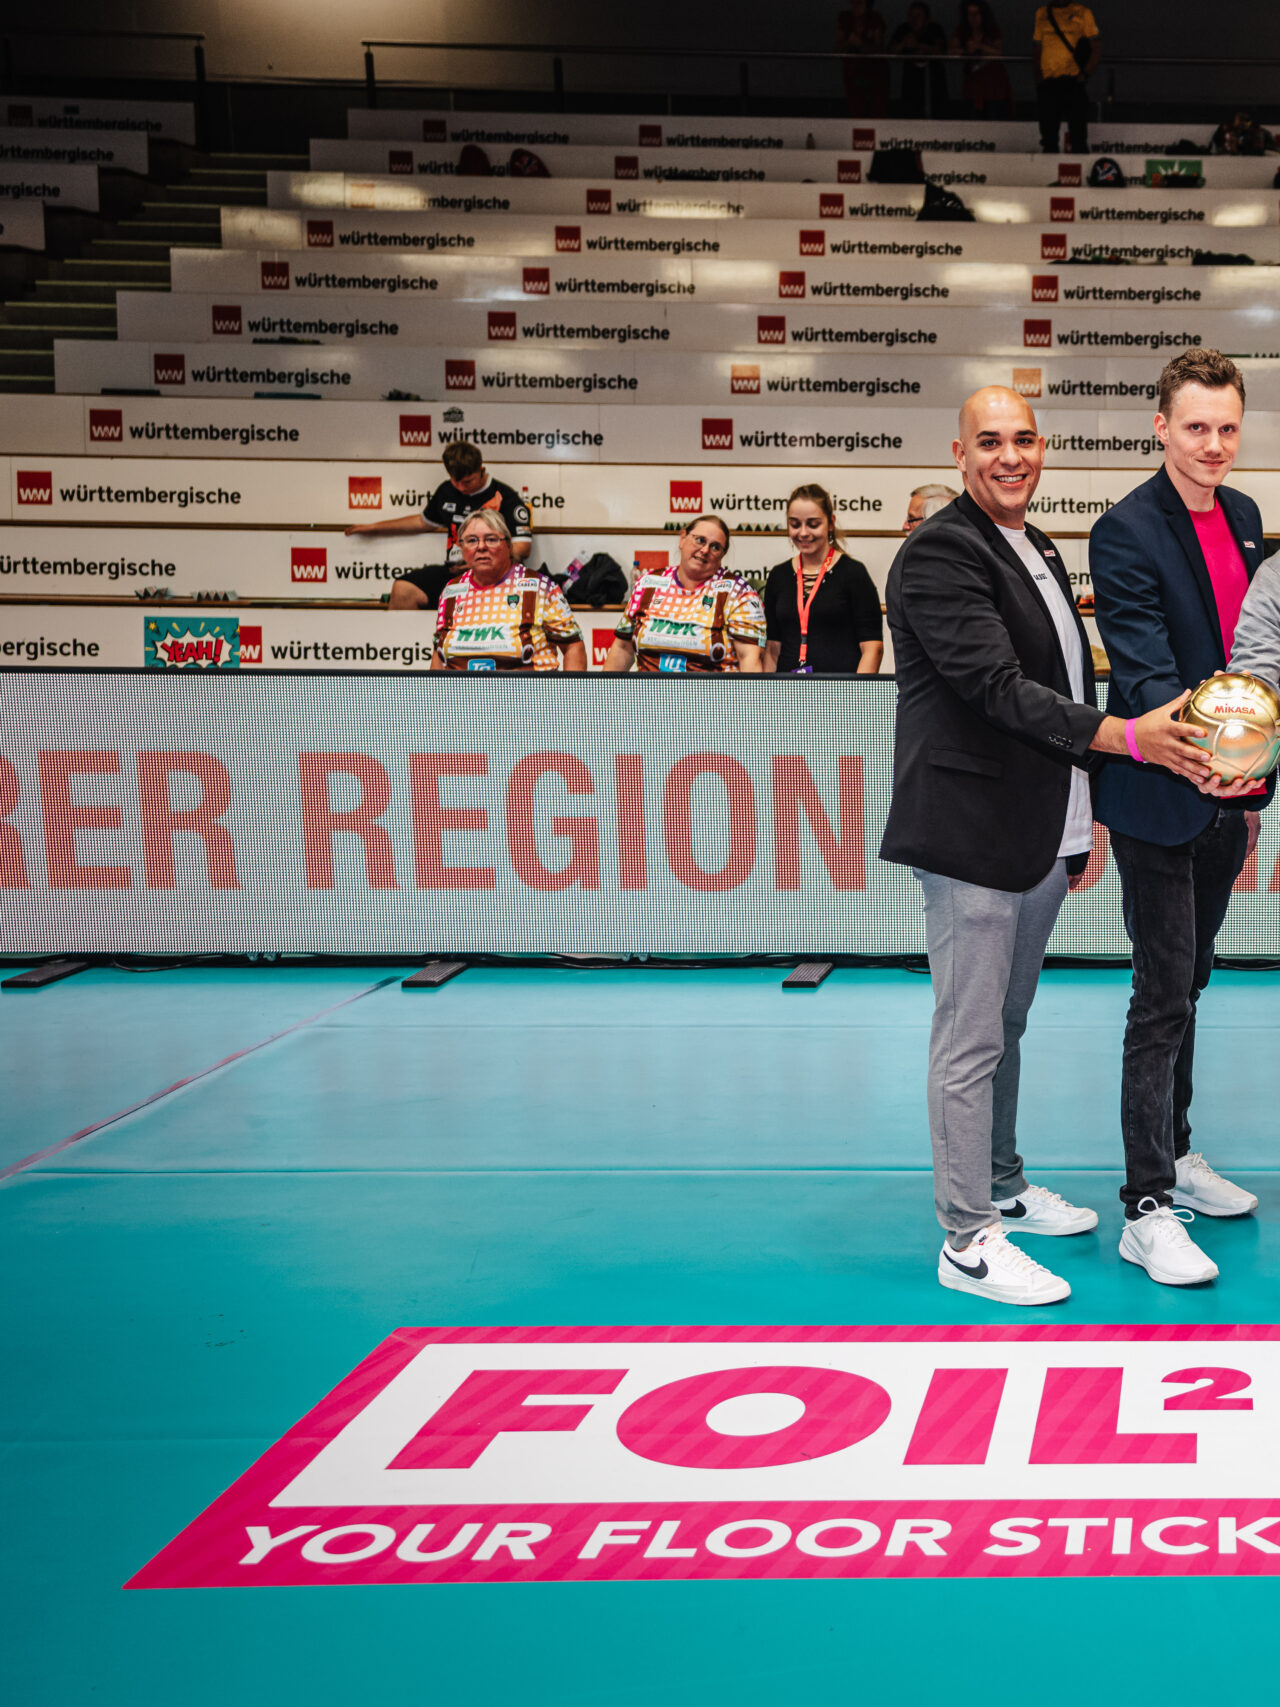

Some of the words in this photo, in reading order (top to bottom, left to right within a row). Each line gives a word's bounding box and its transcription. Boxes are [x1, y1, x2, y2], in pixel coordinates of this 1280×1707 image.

[339, 231, 475, 251] württembergische
[587, 238, 719, 254] württembergische
[830, 242, 962, 258] württembergische
[295, 274, 438, 292] württembergische
[555, 278, 695, 296] württembergische
[811, 282, 949, 301] württembergische
[1064, 285, 1200, 303] württembergische
[248, 318, 398, 337] württembergische
[522, 324, 670, 342] württembergische
[791, 328, 937, 347] württembergische
[1057, 331, 1201, 350] württembergische
[192, 367, 351, 387] württembergische
[482, 372, 638, 392] württembergische
[767, 377, 920, 398] württembergische
[129, 422, 299, 444] württembergische
[438, 428, 603, 449] württembergische
[740, 431, 902, 452] württembergische
[60, 484, 241, 507] württembergische
[457, 625, 505, 642] WWK
[649, 618, 697, 637] WWK
[159, 636, 223, 664] YEAH!
[298, 751, 867, 893] REGION
[238, 1521, 552, 1567] YOUR
[577, 1516, 955, 1561] FLOOR
